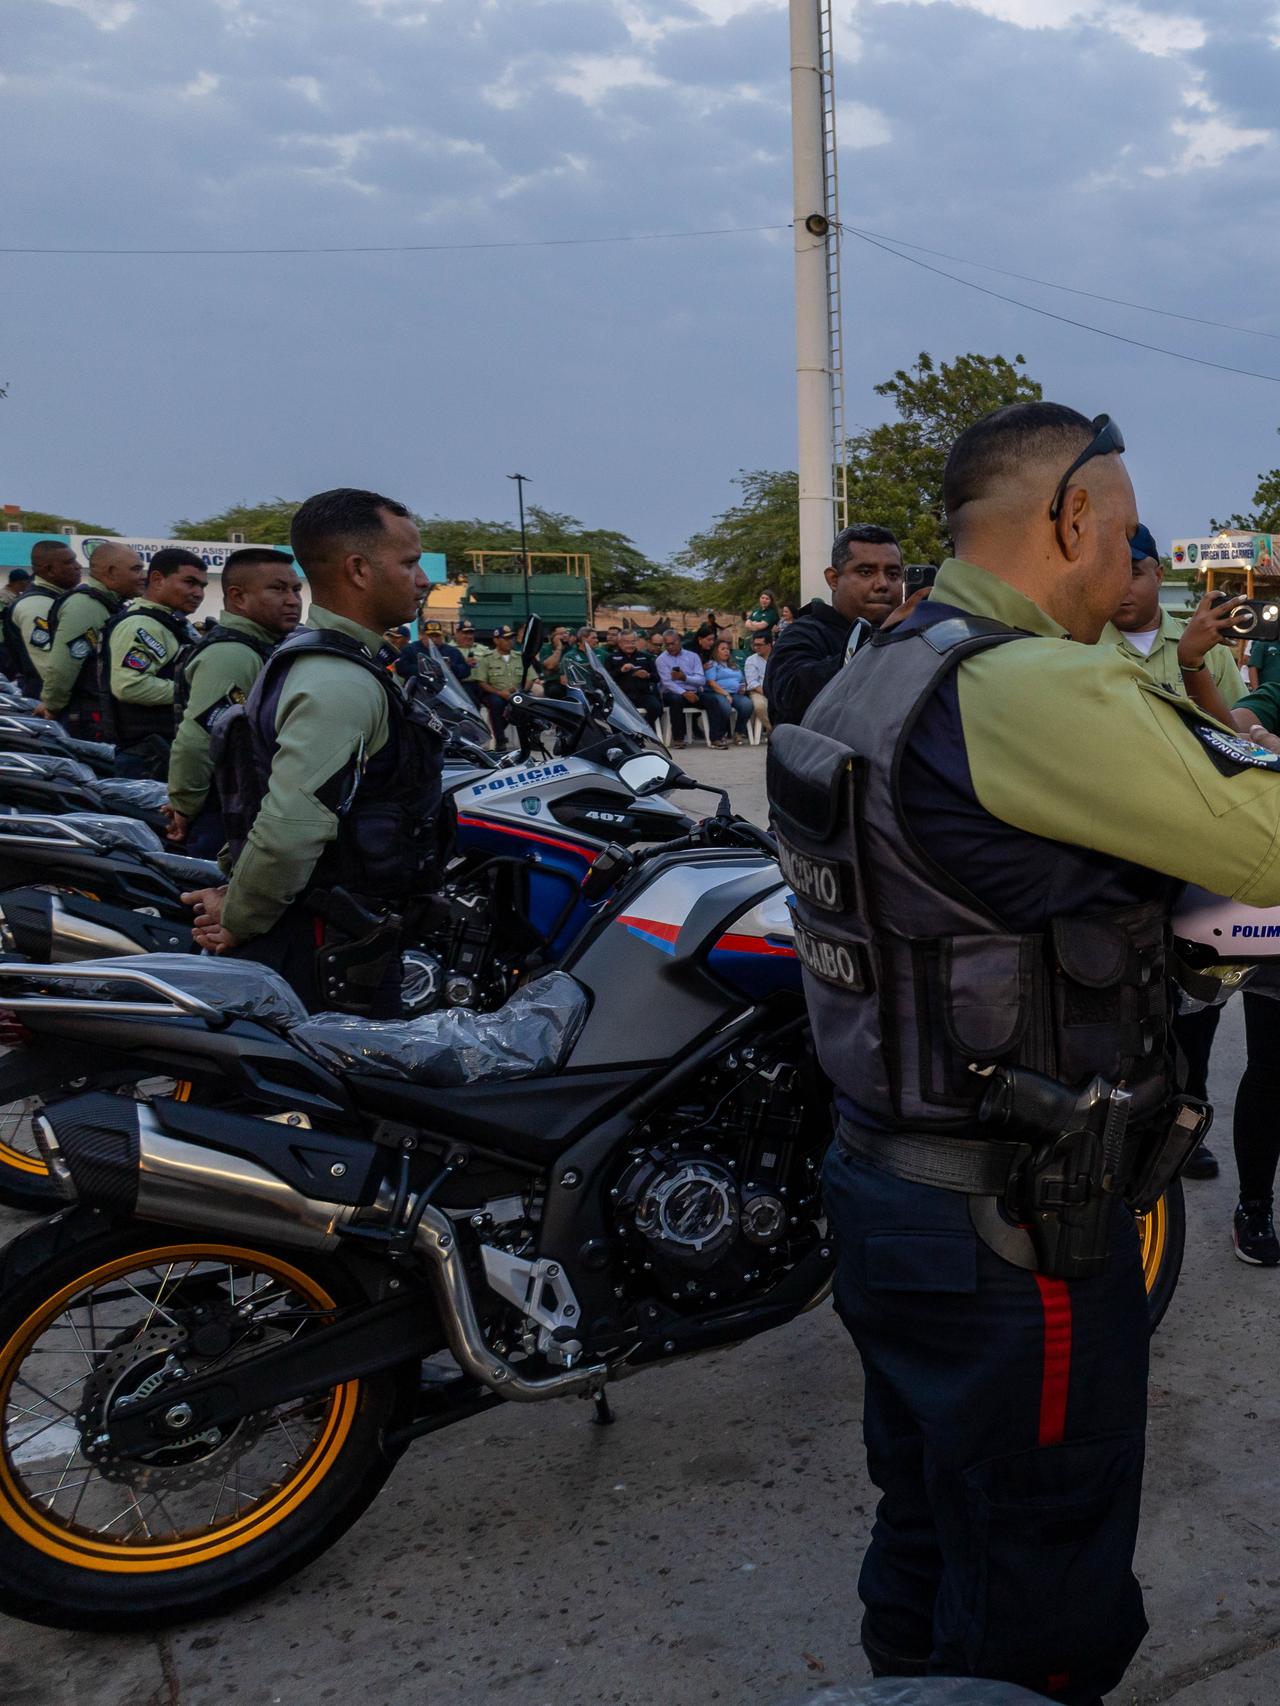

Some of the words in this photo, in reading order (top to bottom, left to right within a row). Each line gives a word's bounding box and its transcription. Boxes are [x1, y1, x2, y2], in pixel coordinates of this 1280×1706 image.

[127, 543, 159, 553] NIDAD
[201, 546, 237, 556] ASISTE
[1200, 550, 1220, 560] VIRGEN
[1220, 550, 1230, 560] DEL
[1231, 549, 1255, 559] CARMEN
[471, 763, 569, 796] POLICIA
[585, 810, 626, 823] 407
